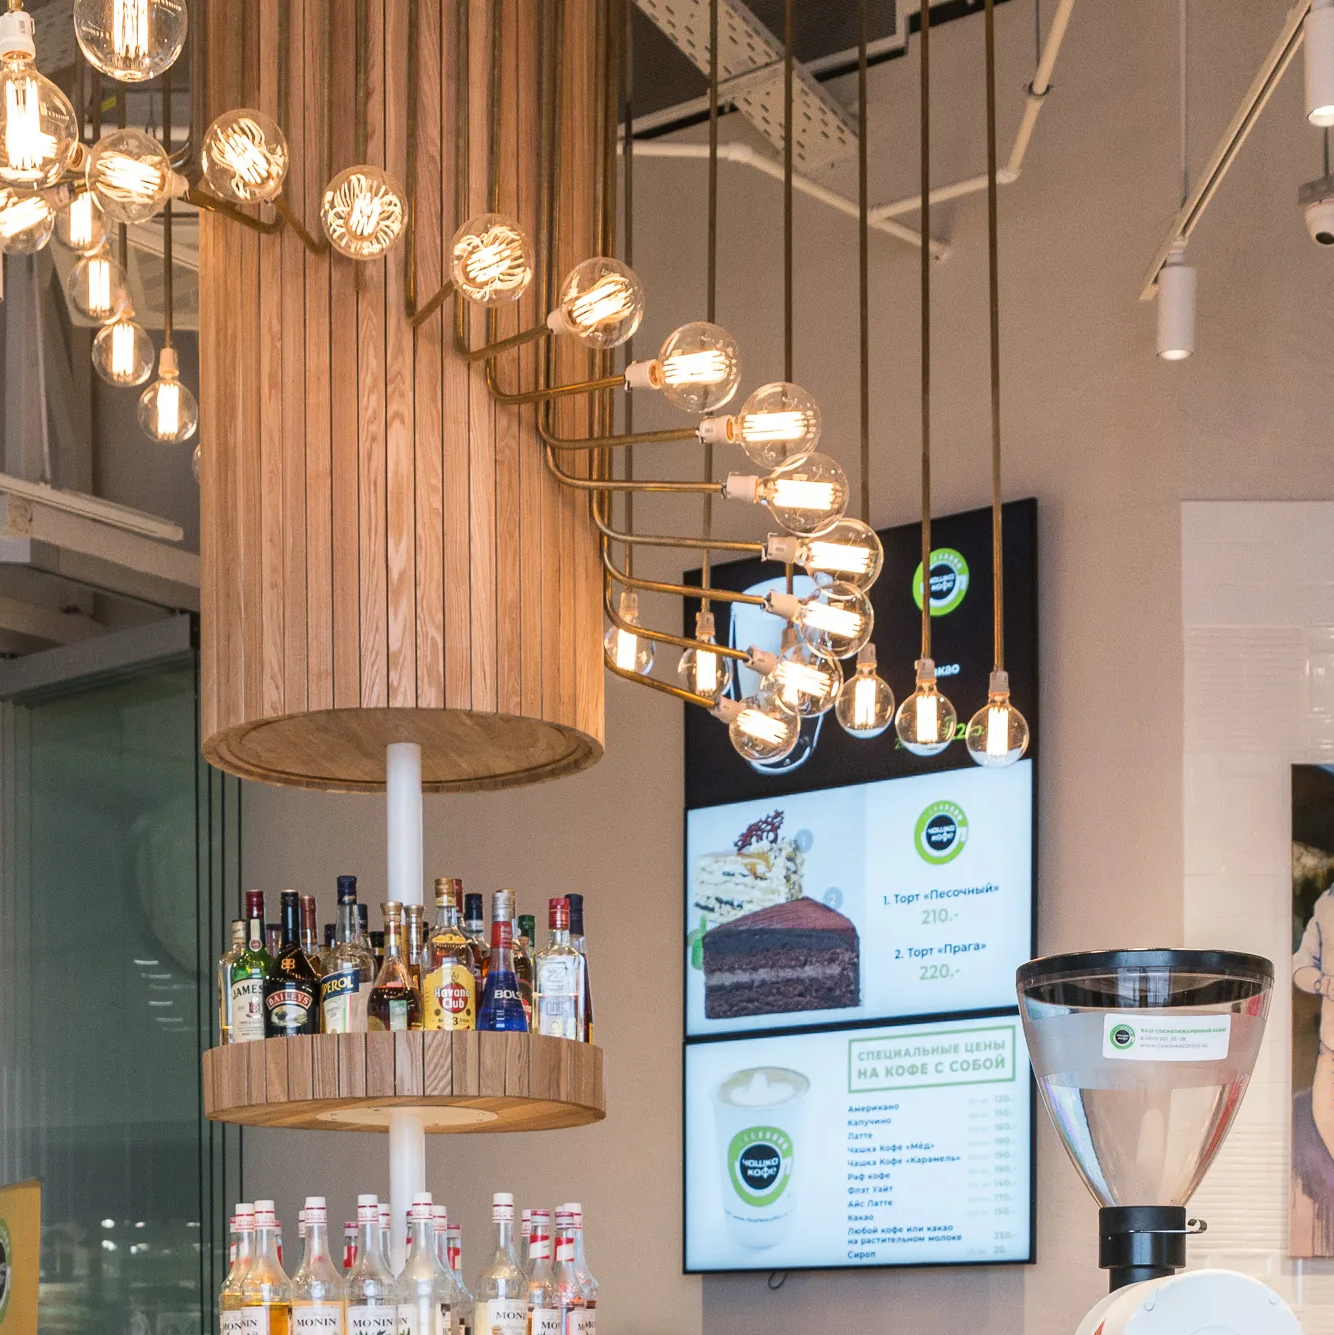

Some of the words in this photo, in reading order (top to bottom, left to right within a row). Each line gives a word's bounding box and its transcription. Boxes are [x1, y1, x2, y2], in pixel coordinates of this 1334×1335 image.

[883, 895, 890, 905] 1.
[894, 893, 920, 905] Торт
[924, 883, 999, 900] «Песочный»
[895, 949, 903, 959] 2.
[907, 947, 934, 959] Торт
[938, 942, 986, 956] «Прага»
[232, 982, 264, 1000] JAMES
[434, 986, 471, 998] Havana
[494, 989, 523, 1000] BOLS
[267, 991, 310, 1007] BAILEYS
[442, 999, 465, 1009] Club
[858, 1043, 960, 1062] СПЕЦИАЛЬНЫЕ
[965, 1040, 1006, 1054] ЦЕНЫ
[857, 1066, 879, 1080] НА
[885, 1062, 928, 1077] КОФЕ
[935, 1062, 944, 1073] С
[949, 1054, 1005, 1072] СОБОЙ
[847, 1103, 899, 1113] Американо
[847, 1117, 891, 1127] Капучино
[847, 1132, 873, 1140] Латте
[879, 1144, 903, 1153] Кофе
[847, 1159, 876, 1167] Чашка
[879, 1158, 903, 1166] Кофе
[847, 1173, 865, 1182] Раф
[868, 1172, 891, 1180] кофе
[847, 1186, 870, 1194] Флэт
[872, 1185, 893, 1193] Уайт
[847, 1200, 865, 1208] Айс
[867, 1199, 893, 1207] Латте
[881, 1226, 904, 1234] кофе
[927, 1224, 954, 1232] какао
[860, 1236, 925, 1245] растительном
[847, 1251, 876, 1260] Сироп
[297, 1318, 337, 1327] MONIN
[353, 1318, 393, 1328] MONIN
